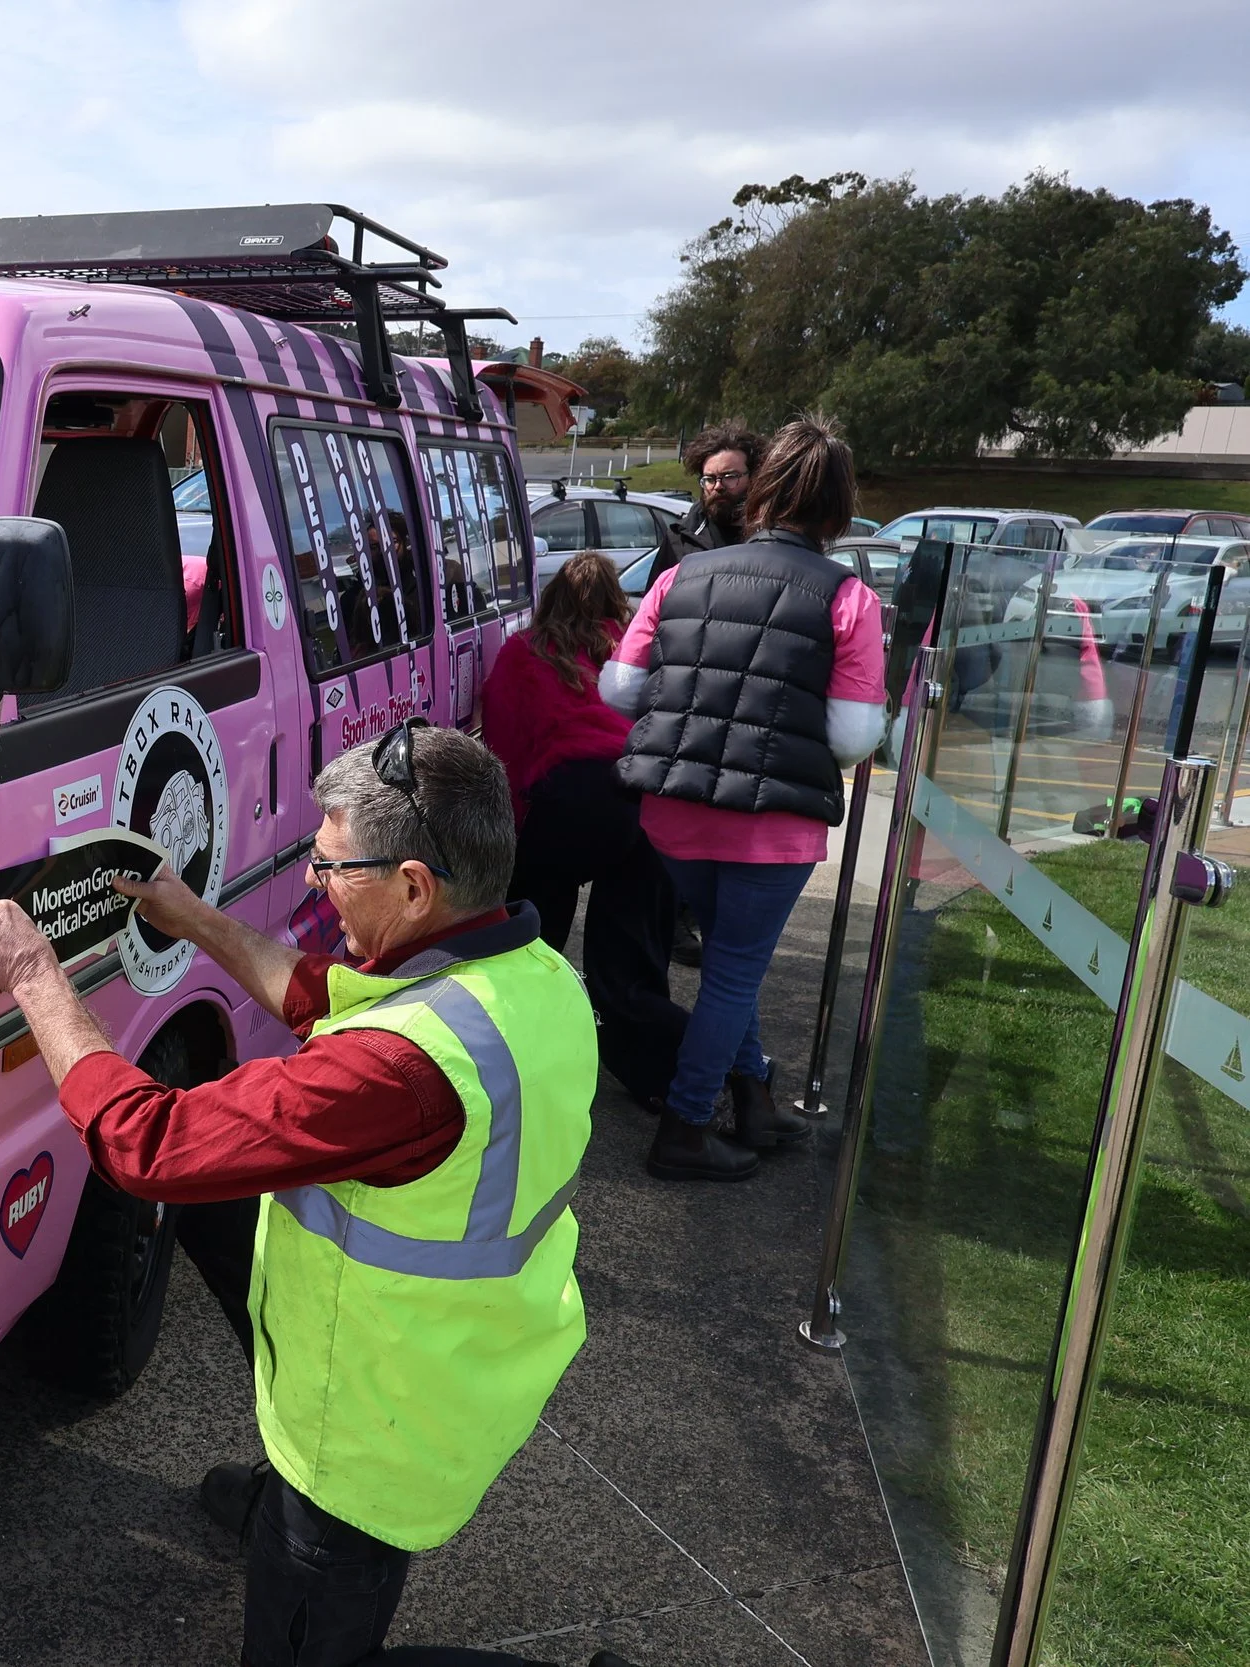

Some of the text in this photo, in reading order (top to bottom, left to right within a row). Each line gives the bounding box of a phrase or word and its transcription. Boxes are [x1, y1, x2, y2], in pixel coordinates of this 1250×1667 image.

[341, 710, 367, 750] Spot
[369, 704, 386, 737] the
[116, 701, 221, 828] ITBOX RALLY
[69, 785, 99, 810] Cruisin'
[32, 878, 91, 917] Moreton
[81, 889, 130, 927] Services
[8, 1175, 48, 1229] RUBY
